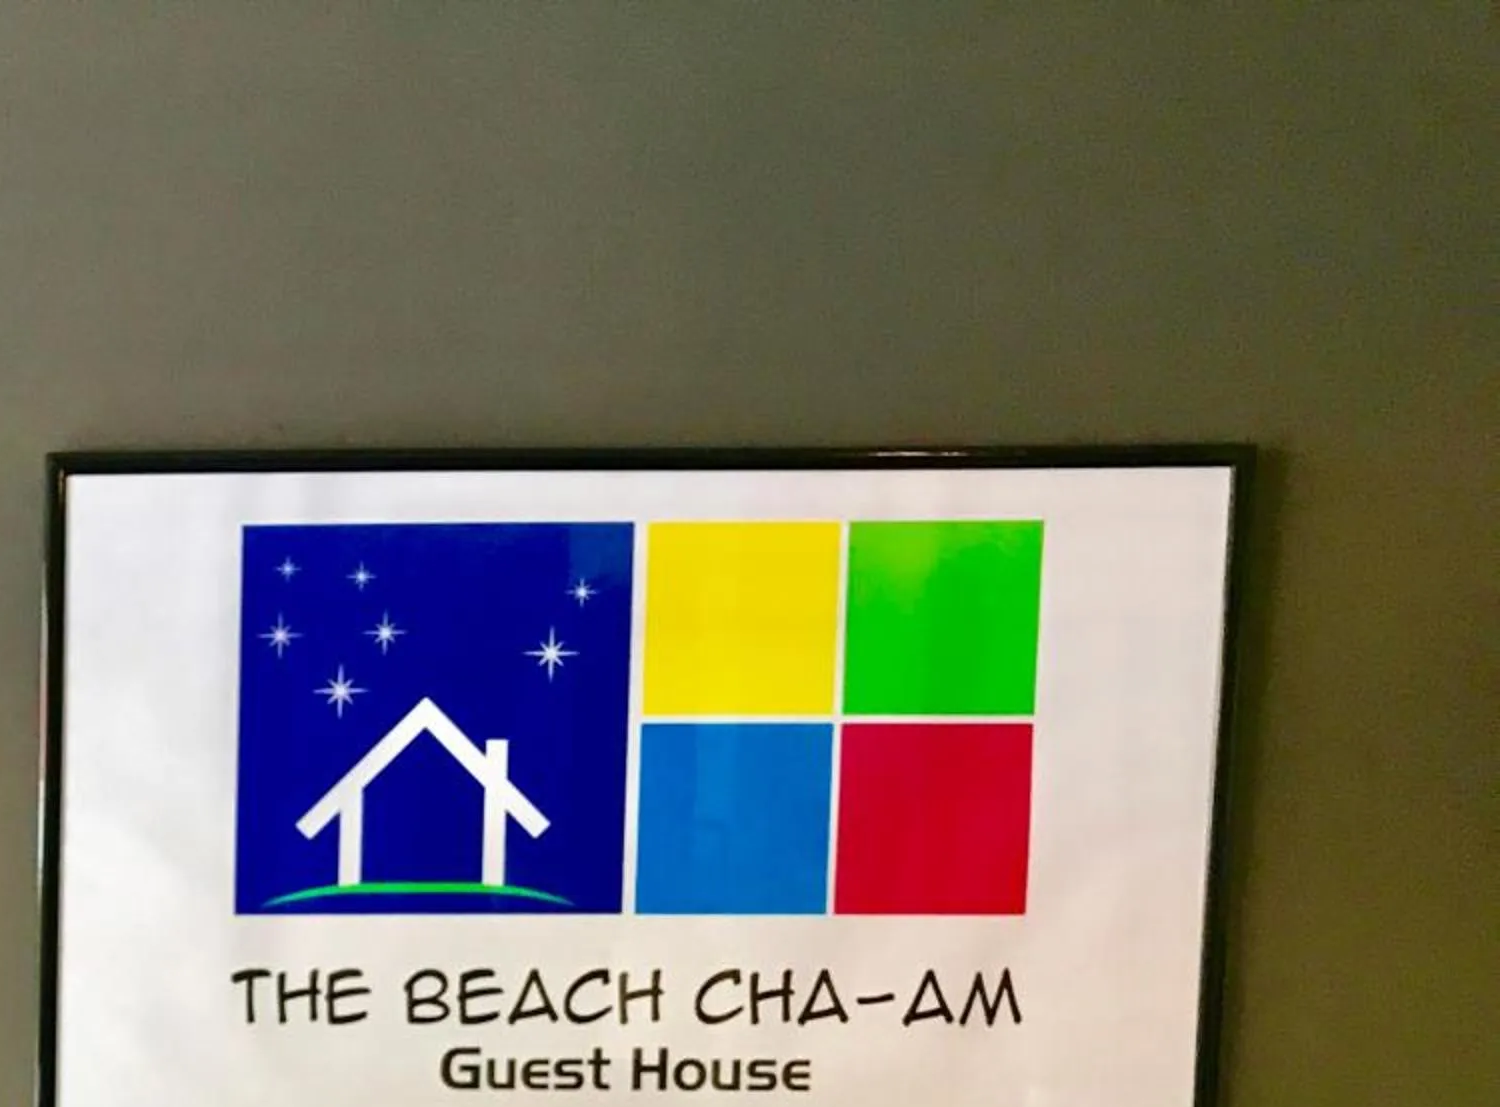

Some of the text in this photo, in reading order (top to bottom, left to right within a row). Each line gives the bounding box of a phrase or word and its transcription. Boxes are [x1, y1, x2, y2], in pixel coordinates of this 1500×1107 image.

[231, 967, 1022, 1027] THE BEACH CHA-AM
[441, 1047, 811, 1092] Guest House
